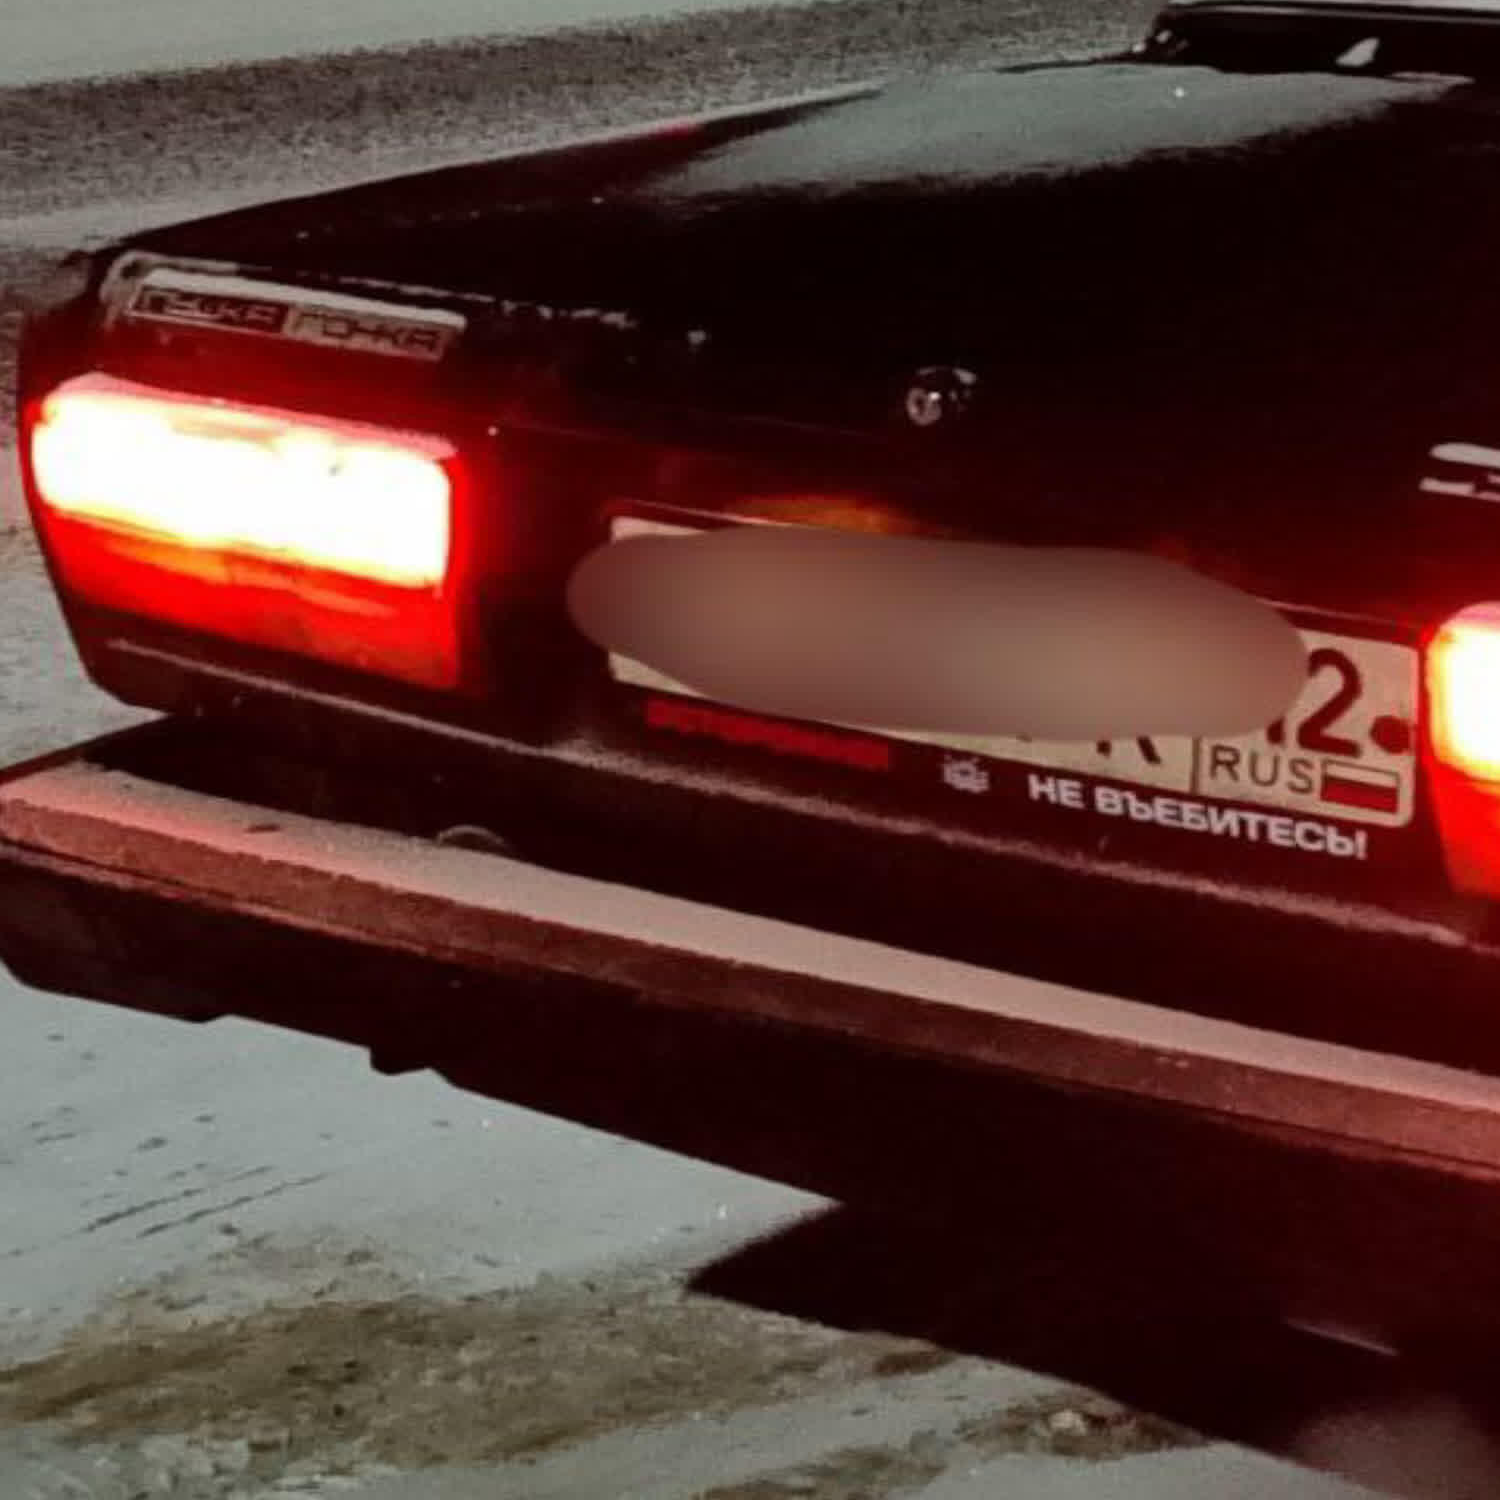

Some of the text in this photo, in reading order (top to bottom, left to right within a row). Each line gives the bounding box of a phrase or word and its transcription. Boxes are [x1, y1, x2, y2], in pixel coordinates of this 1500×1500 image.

[1209, 744, 1315, 795] RUS
[1027, 773, 1367, 861] НЕ ВЪЕБИТЕСЬ!
